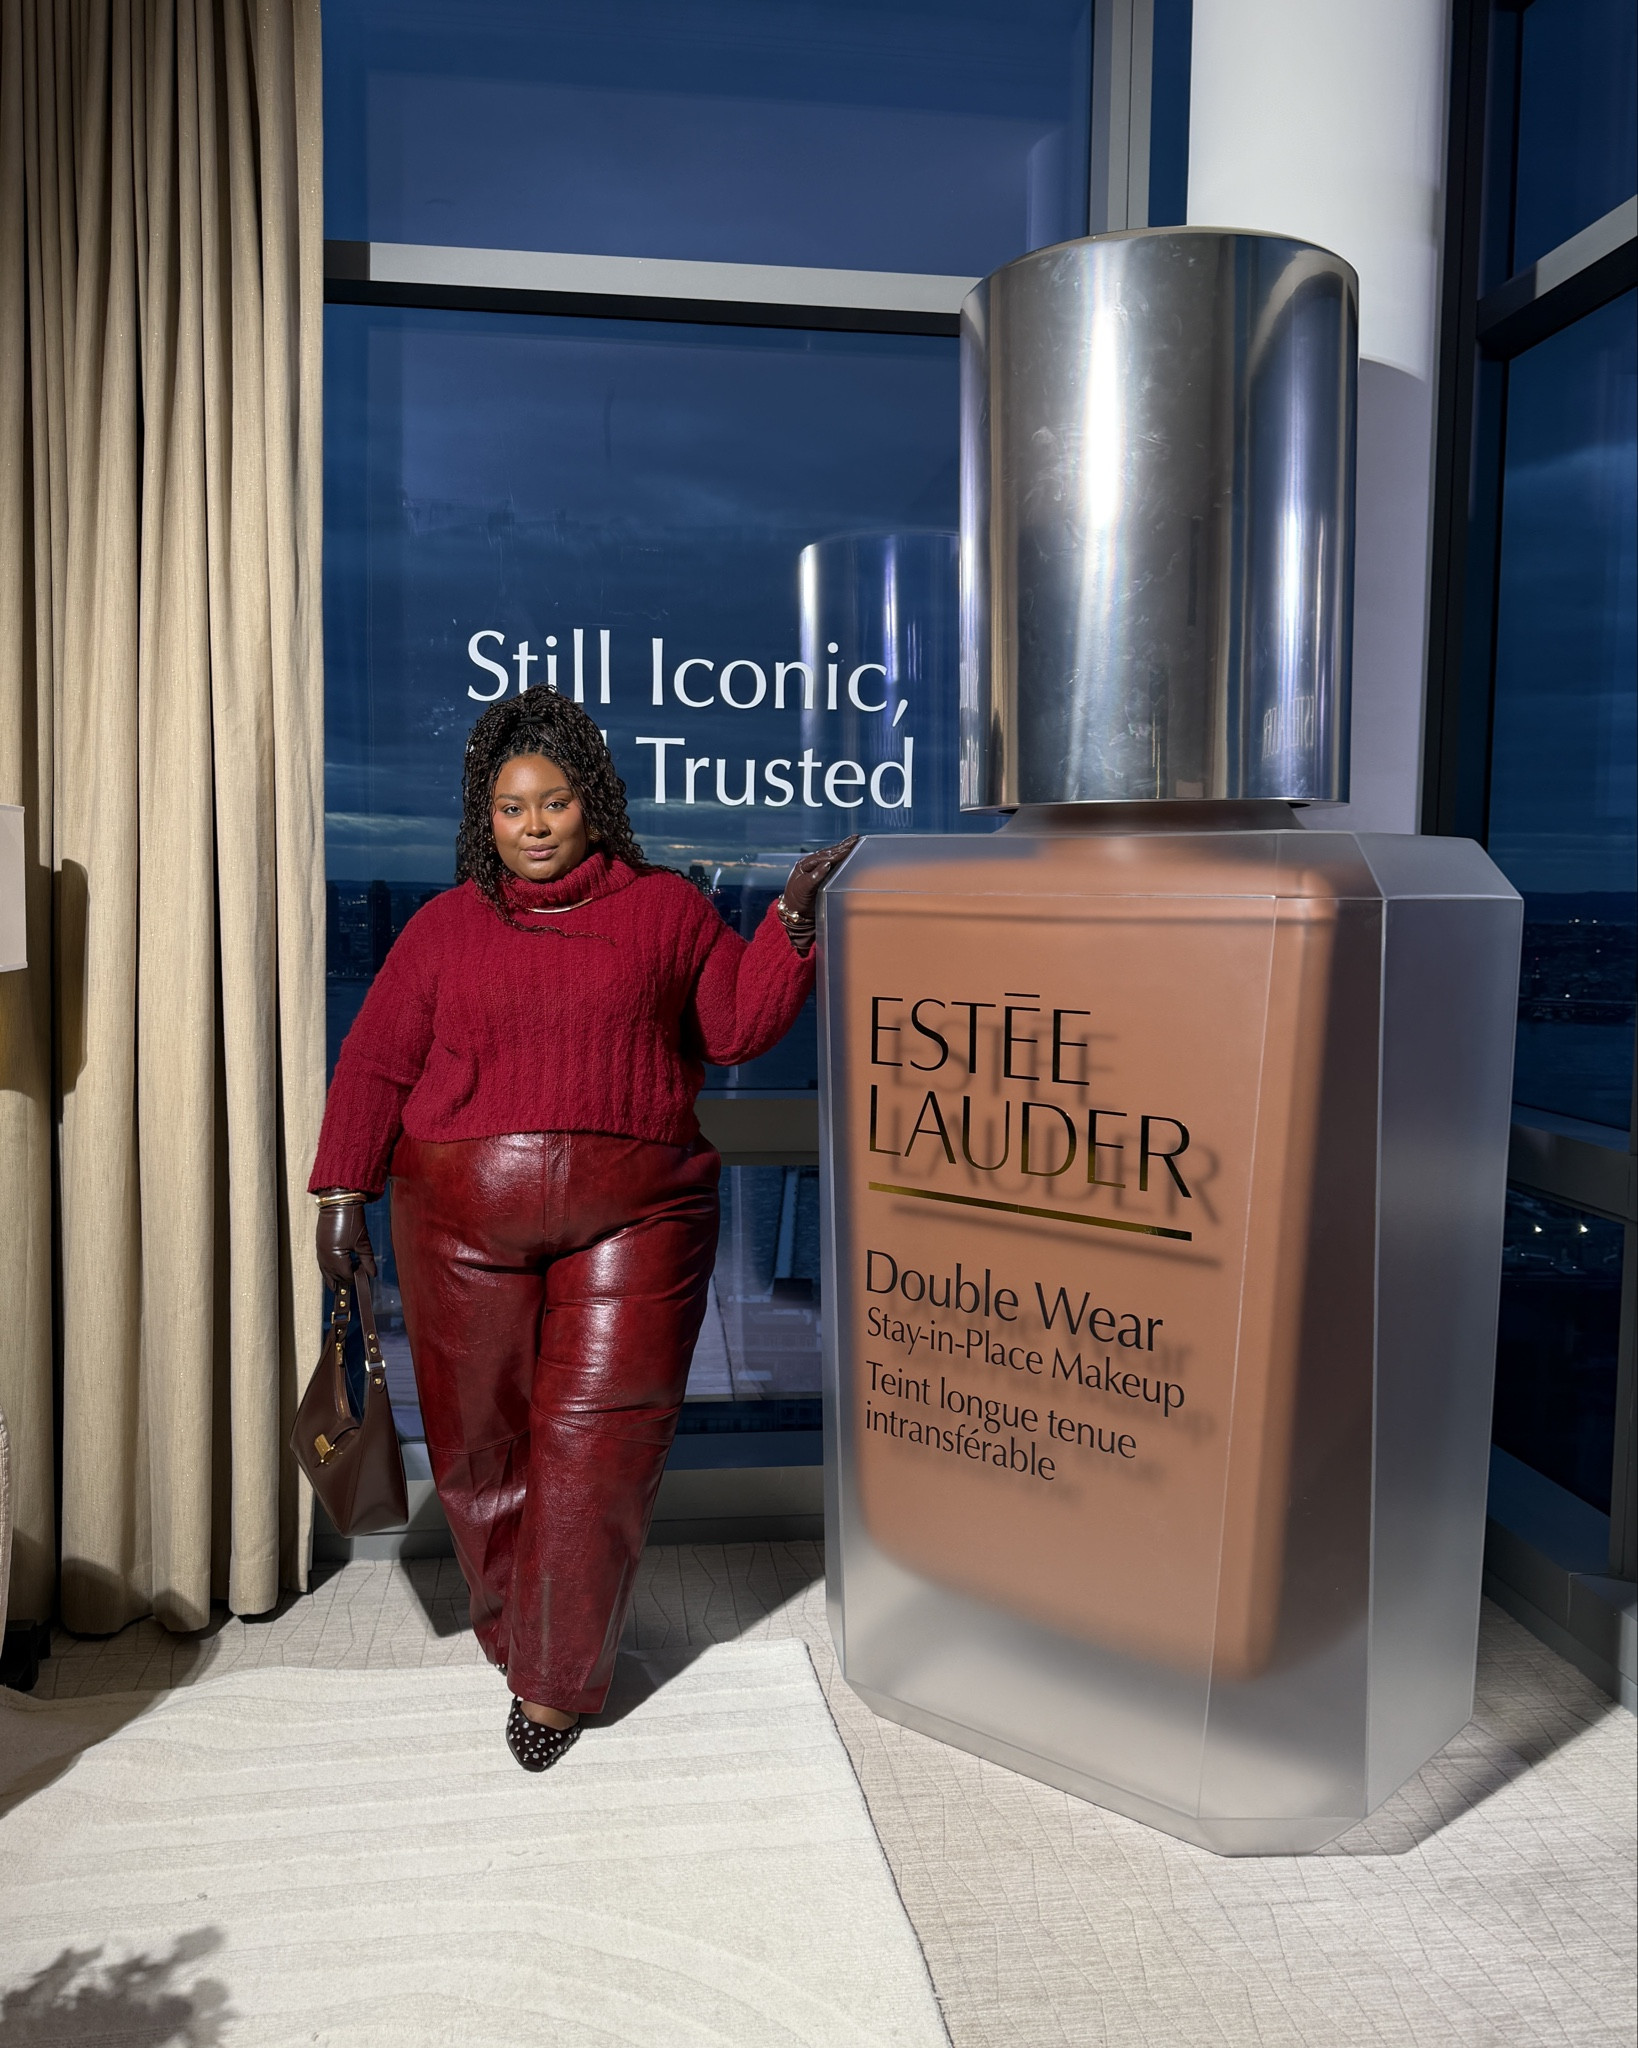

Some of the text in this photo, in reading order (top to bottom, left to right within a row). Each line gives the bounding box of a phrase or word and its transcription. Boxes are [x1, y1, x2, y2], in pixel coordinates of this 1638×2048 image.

[467, 628, 611, 704] Still
[652, 637, 909, 728] Iconic,
[635, 736, 915, 809] Trusted
[868, 1083, 1193, 1199] LAUDER
[865, 1249, 1164, 1352] Double Wear
[865, 1360, 1137, 1459] Teint longue tenue
[866, 1306, 1186, 1418] Stay-in-Place Makeup
[865, 1400, 1056, 1482] intransférable
